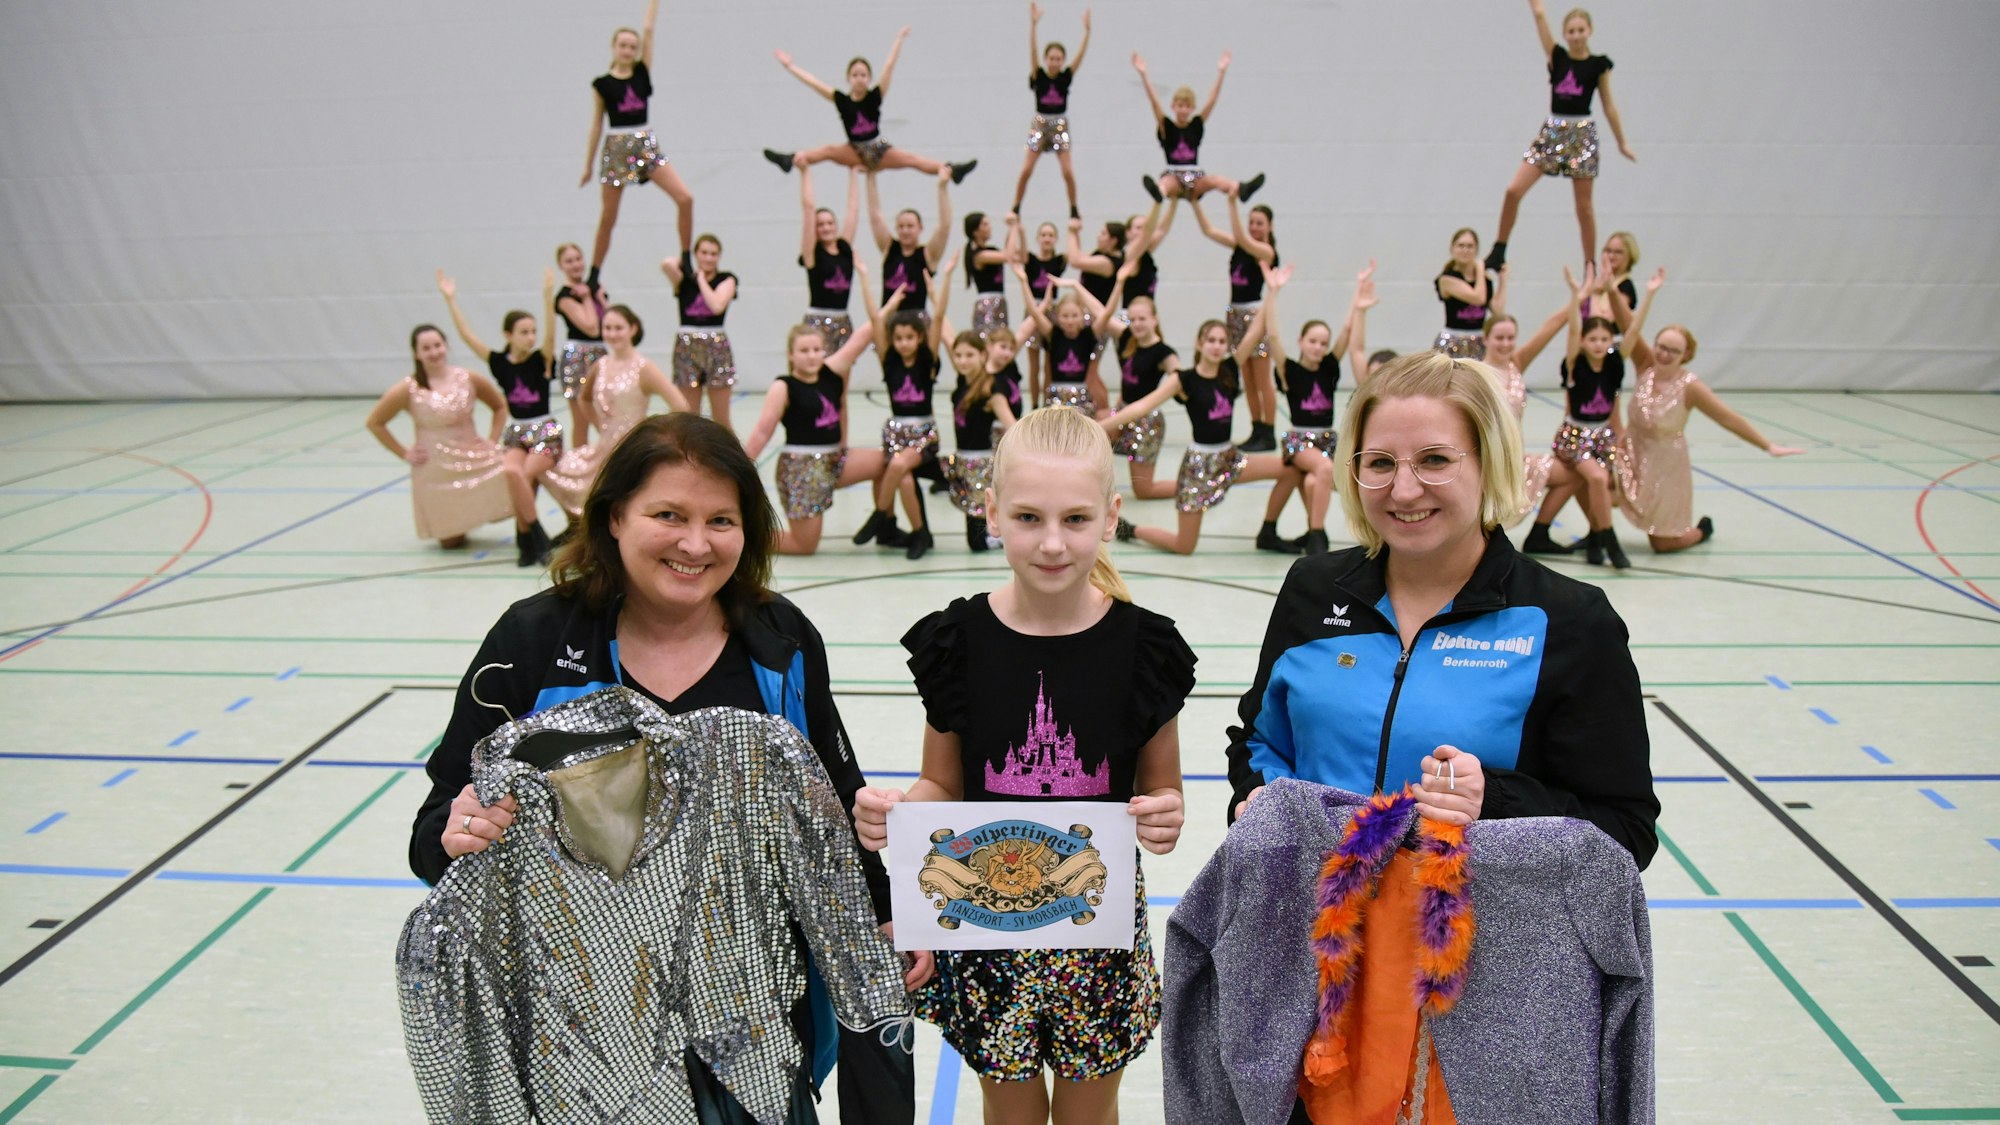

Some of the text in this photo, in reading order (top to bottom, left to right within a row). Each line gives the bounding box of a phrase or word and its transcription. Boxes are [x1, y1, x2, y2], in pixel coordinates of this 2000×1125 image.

[1322, 616, 1351, 627] erima
[1432, 631, 1490, 651] Elektro
[556, 658, 587, 674] erima
[1442, 656, 1508, 669] Berkenroth
[949, 825, 1078, 854] Wolpertinger
[950, 902, 1004, 927] TANZSPORT
[1013, 914, 1025, 928] SV
[1026, 900, 1078, 926] MORSBACH
